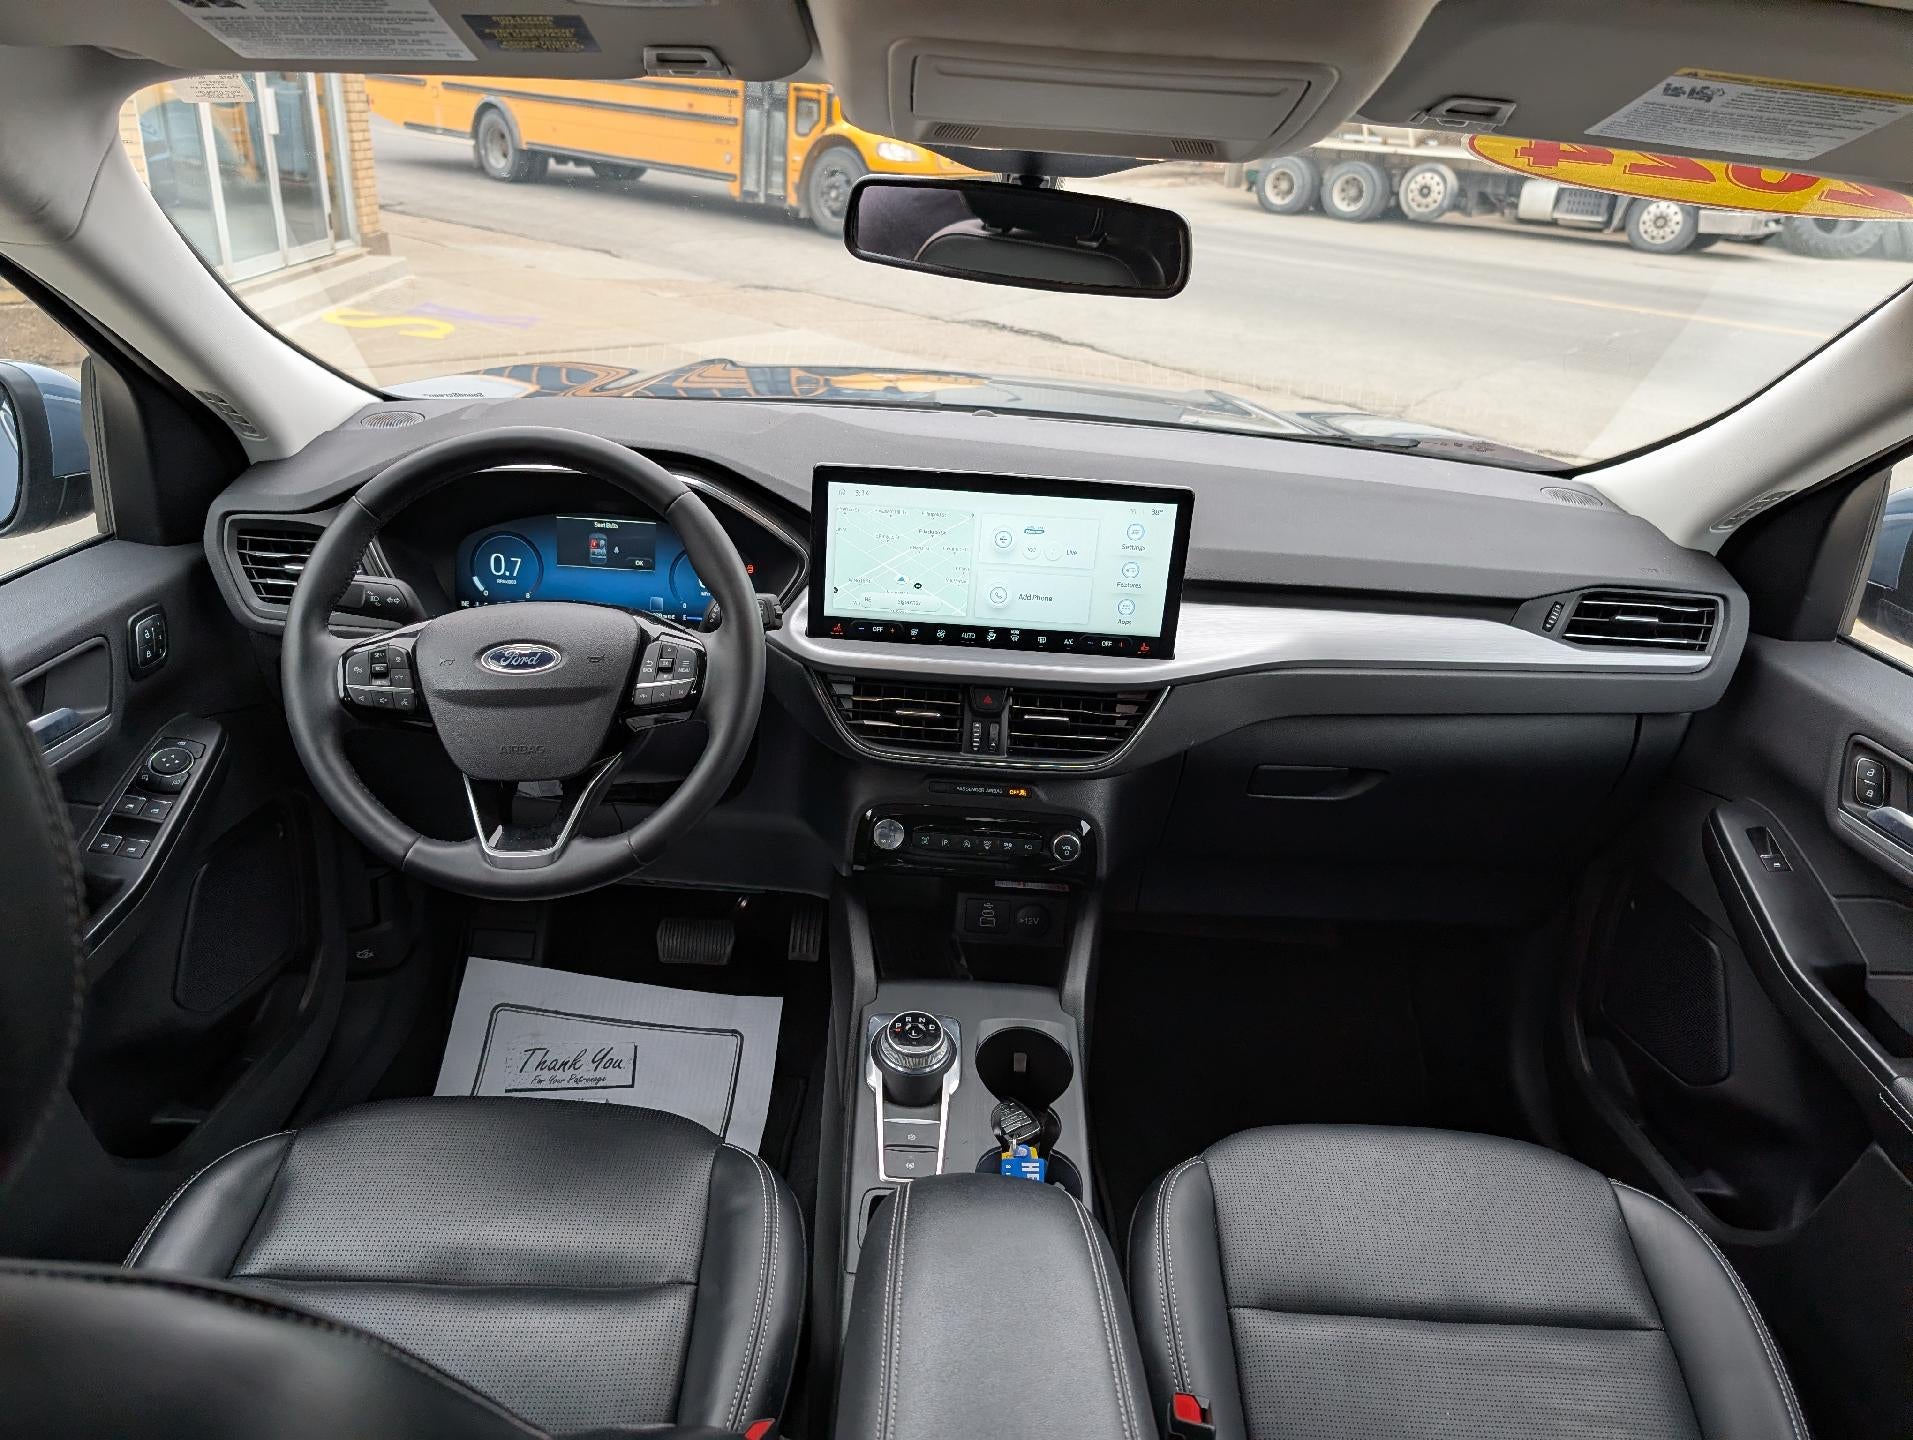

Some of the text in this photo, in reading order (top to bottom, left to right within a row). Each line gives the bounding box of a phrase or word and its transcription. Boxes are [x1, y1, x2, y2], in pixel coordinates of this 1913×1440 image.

[1121, 543, 1146, 551] Settings
[490, 553, 521, 577] 0.7
[1116, 581, 1141, 589] Features
[1032, 594, 1053, 602] Phone
[500, 650, 541, 666] Ford
[519, 1046, 623, 1074] Thank You
[531, 1074, 546, 1086] For
[548, 1074, 566, 1085] Your
